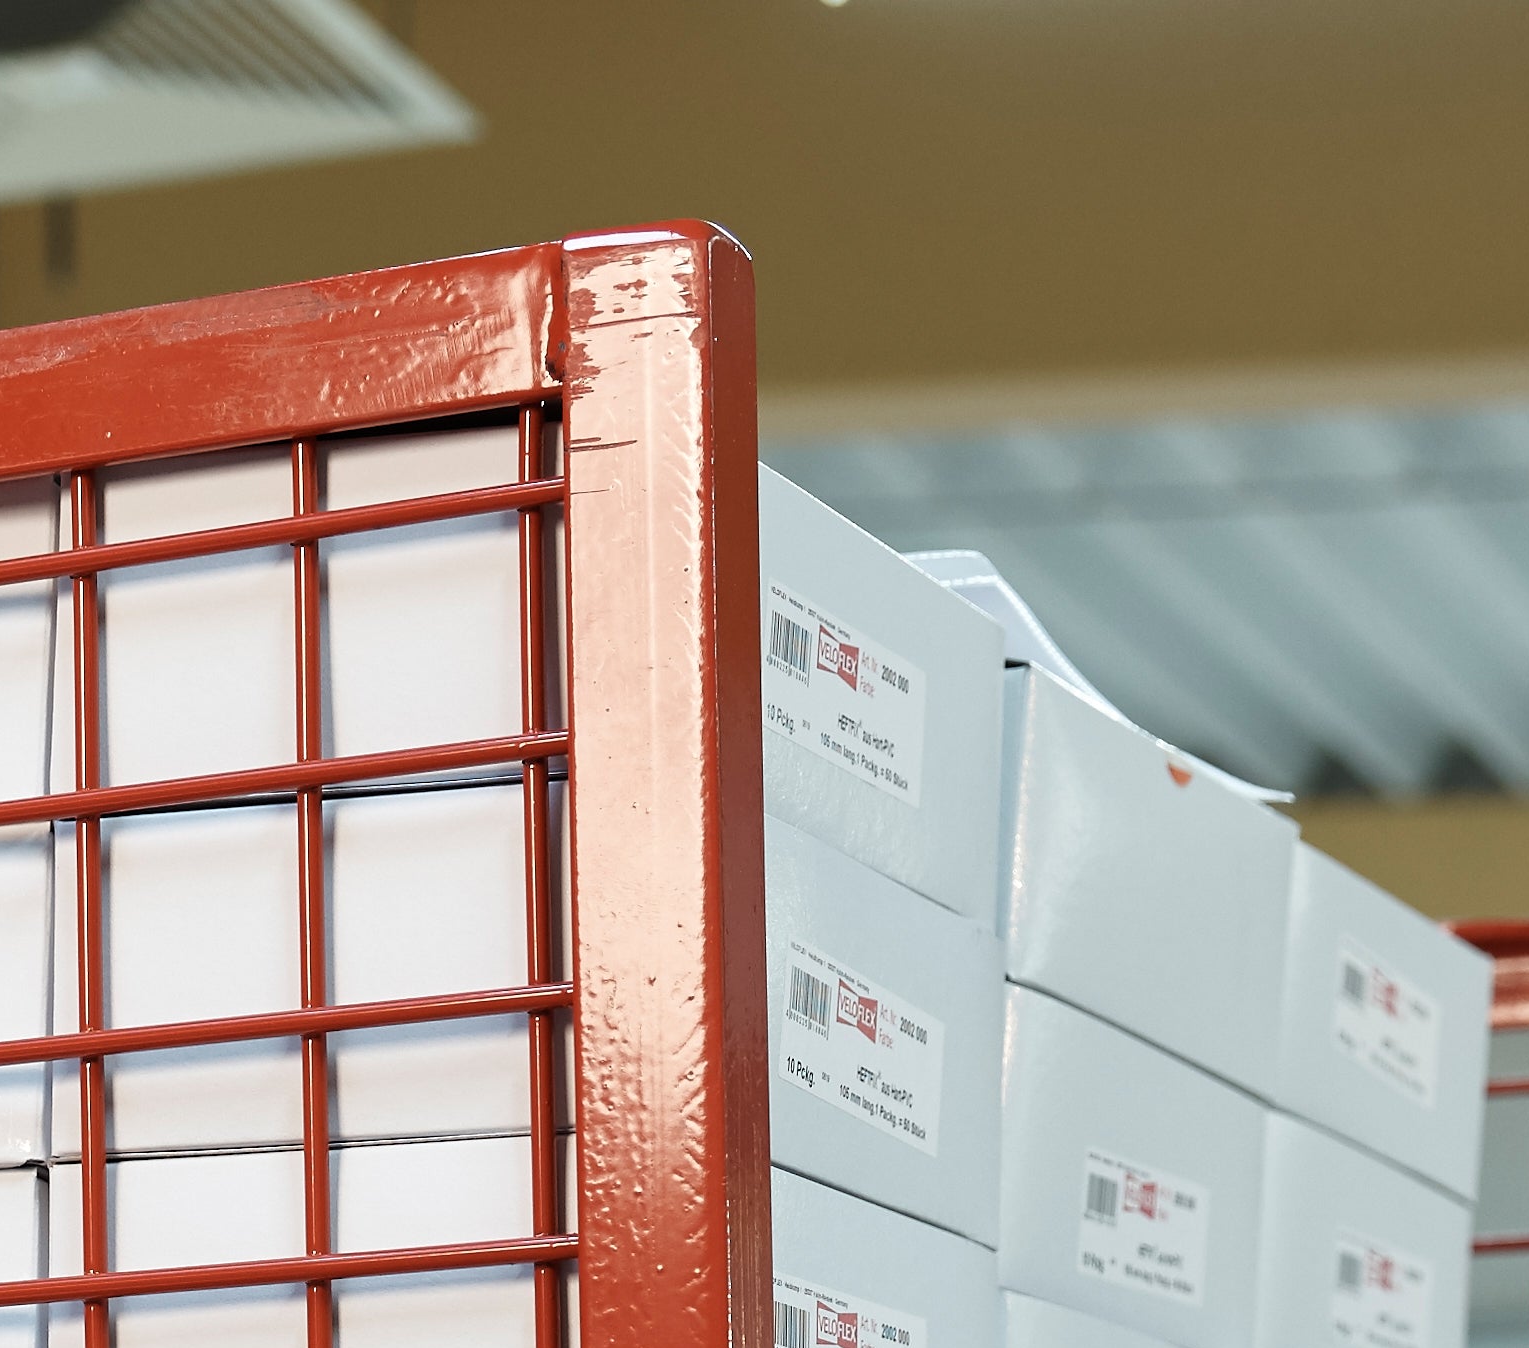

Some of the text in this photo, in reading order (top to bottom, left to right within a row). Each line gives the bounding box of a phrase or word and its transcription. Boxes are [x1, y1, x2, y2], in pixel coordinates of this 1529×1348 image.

[838, 992, 876, 1030] VELOFLEX
[817, 1315, 856, 1344] VELOFLEX
[881, 1323, 896, 1342] 2002
